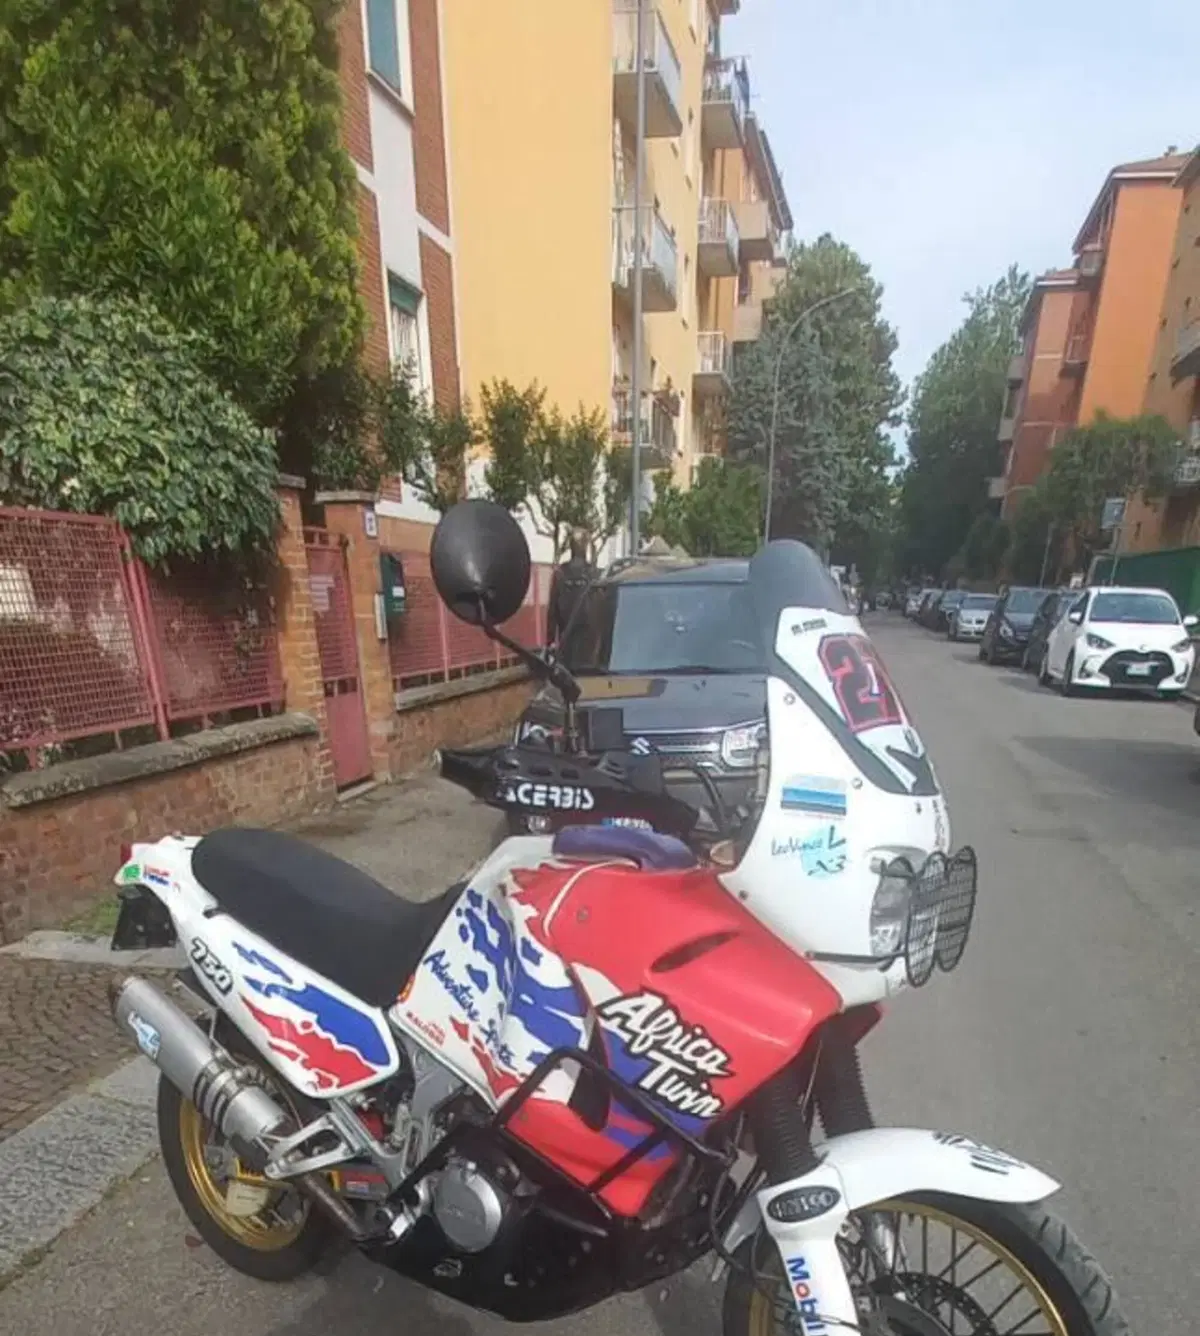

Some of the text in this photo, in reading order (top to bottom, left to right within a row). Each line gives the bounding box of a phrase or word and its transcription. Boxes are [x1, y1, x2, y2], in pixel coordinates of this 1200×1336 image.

[190, 935, 234, 996] 750
[600, 989, 733, 1077] Africa
[639, 1049, 724, 1119] Twin
